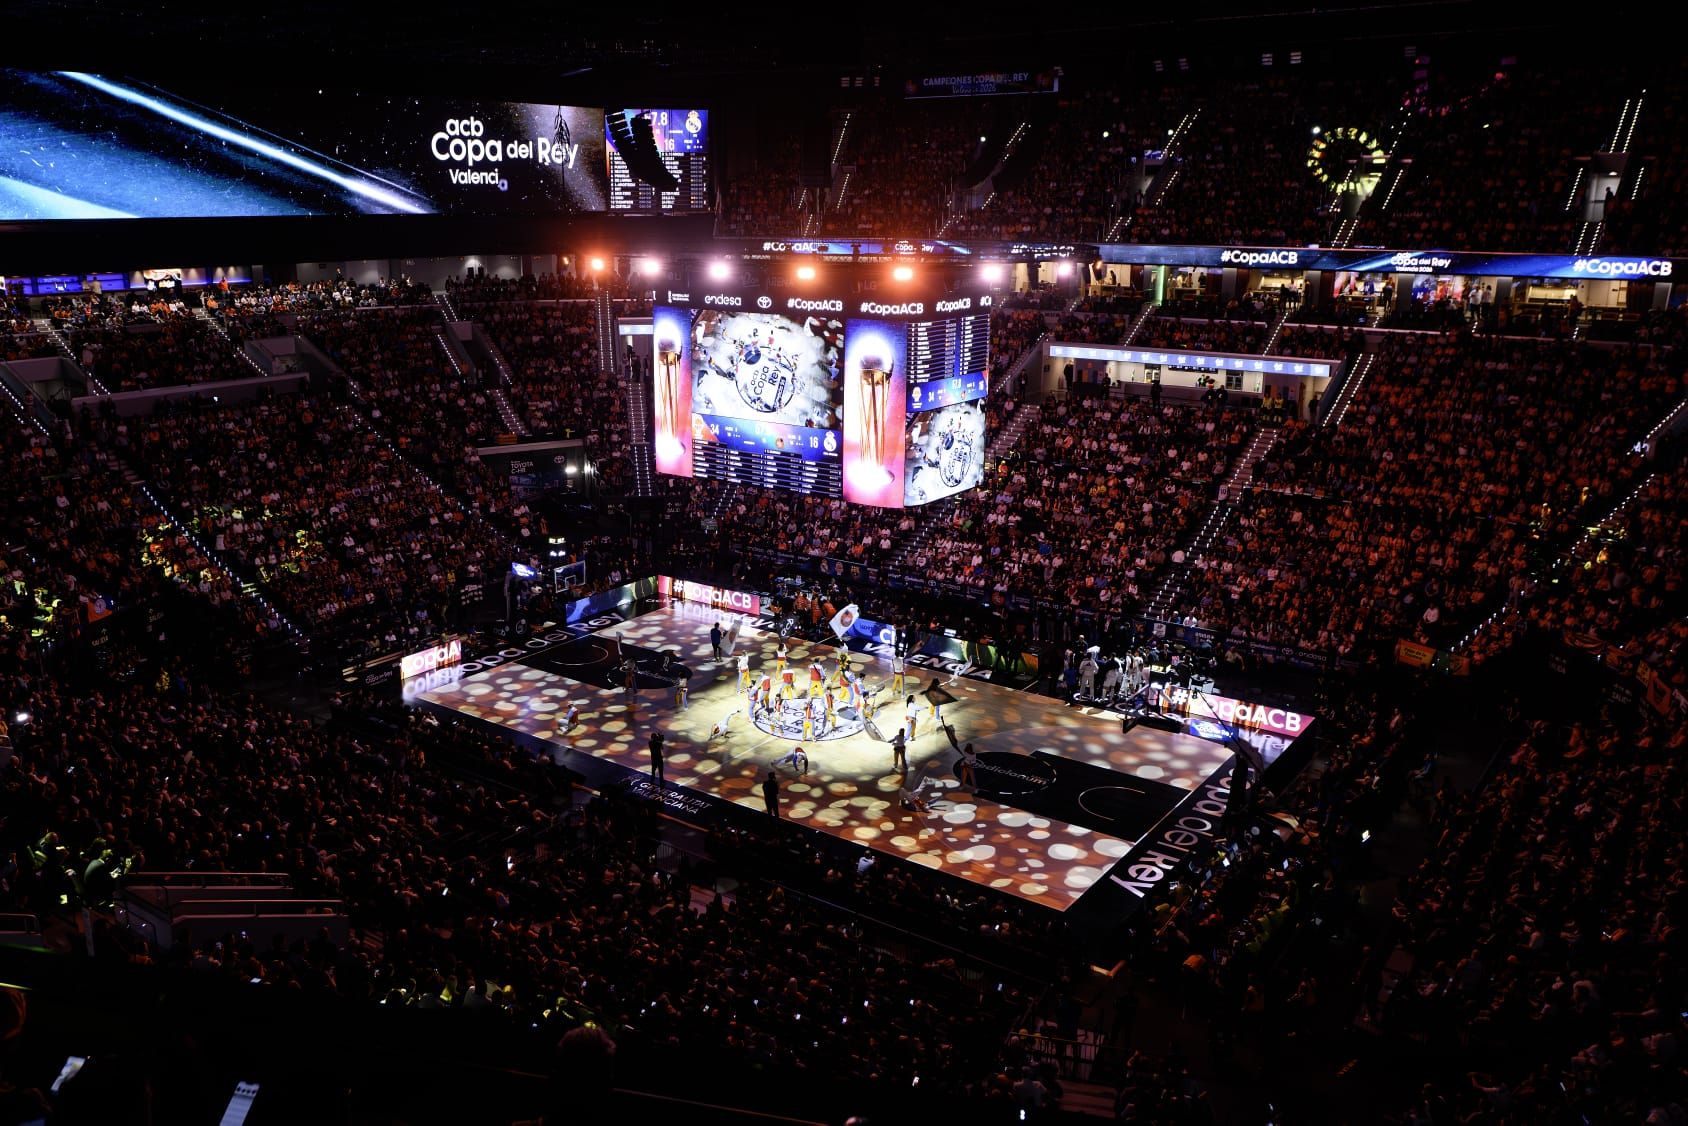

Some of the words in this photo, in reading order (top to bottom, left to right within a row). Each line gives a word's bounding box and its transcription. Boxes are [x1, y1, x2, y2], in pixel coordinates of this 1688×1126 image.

[923, 75, 972, 87] CAMPEONES
[1013, 72, 1029, 81] REY
[445, 116, 484, 138] acb
[431, 131, 503, 166] Copa
[506, 139, 533, 160] del
[537, 137, 578, 169] Rey
[1221, 250, 1298, 266] #CopaACB
[1390, 256, 1418, 266] Copa
[1431, 257, 1451, 268] Rey
[1573, 258, 1672, 276] #CopaACB
[705, 293, 742, 306] endesa
[787, 297, 843, 312] #CopaACB
[935, 297, 971, 313] #CopaACB
[860, 302, 924, 316] #CopaACB
[754, 366, 770, 395] Copa
[767, 366, 782, 386] Rey
[710, 424, 720, 435] 34
[809, 436, 818, 449] 16
[510, 461, 534, 469] TOYOTA
[525, 629, 577, 649] del
[567, 612, 625, 632] Rey
[632, 786, 698, 814] VALENCIANA
[639, 782, 713, 809] GENERALITAT
[1158, 817, 1214, 853] del
[1109, 850, 1181, 899] Rey
